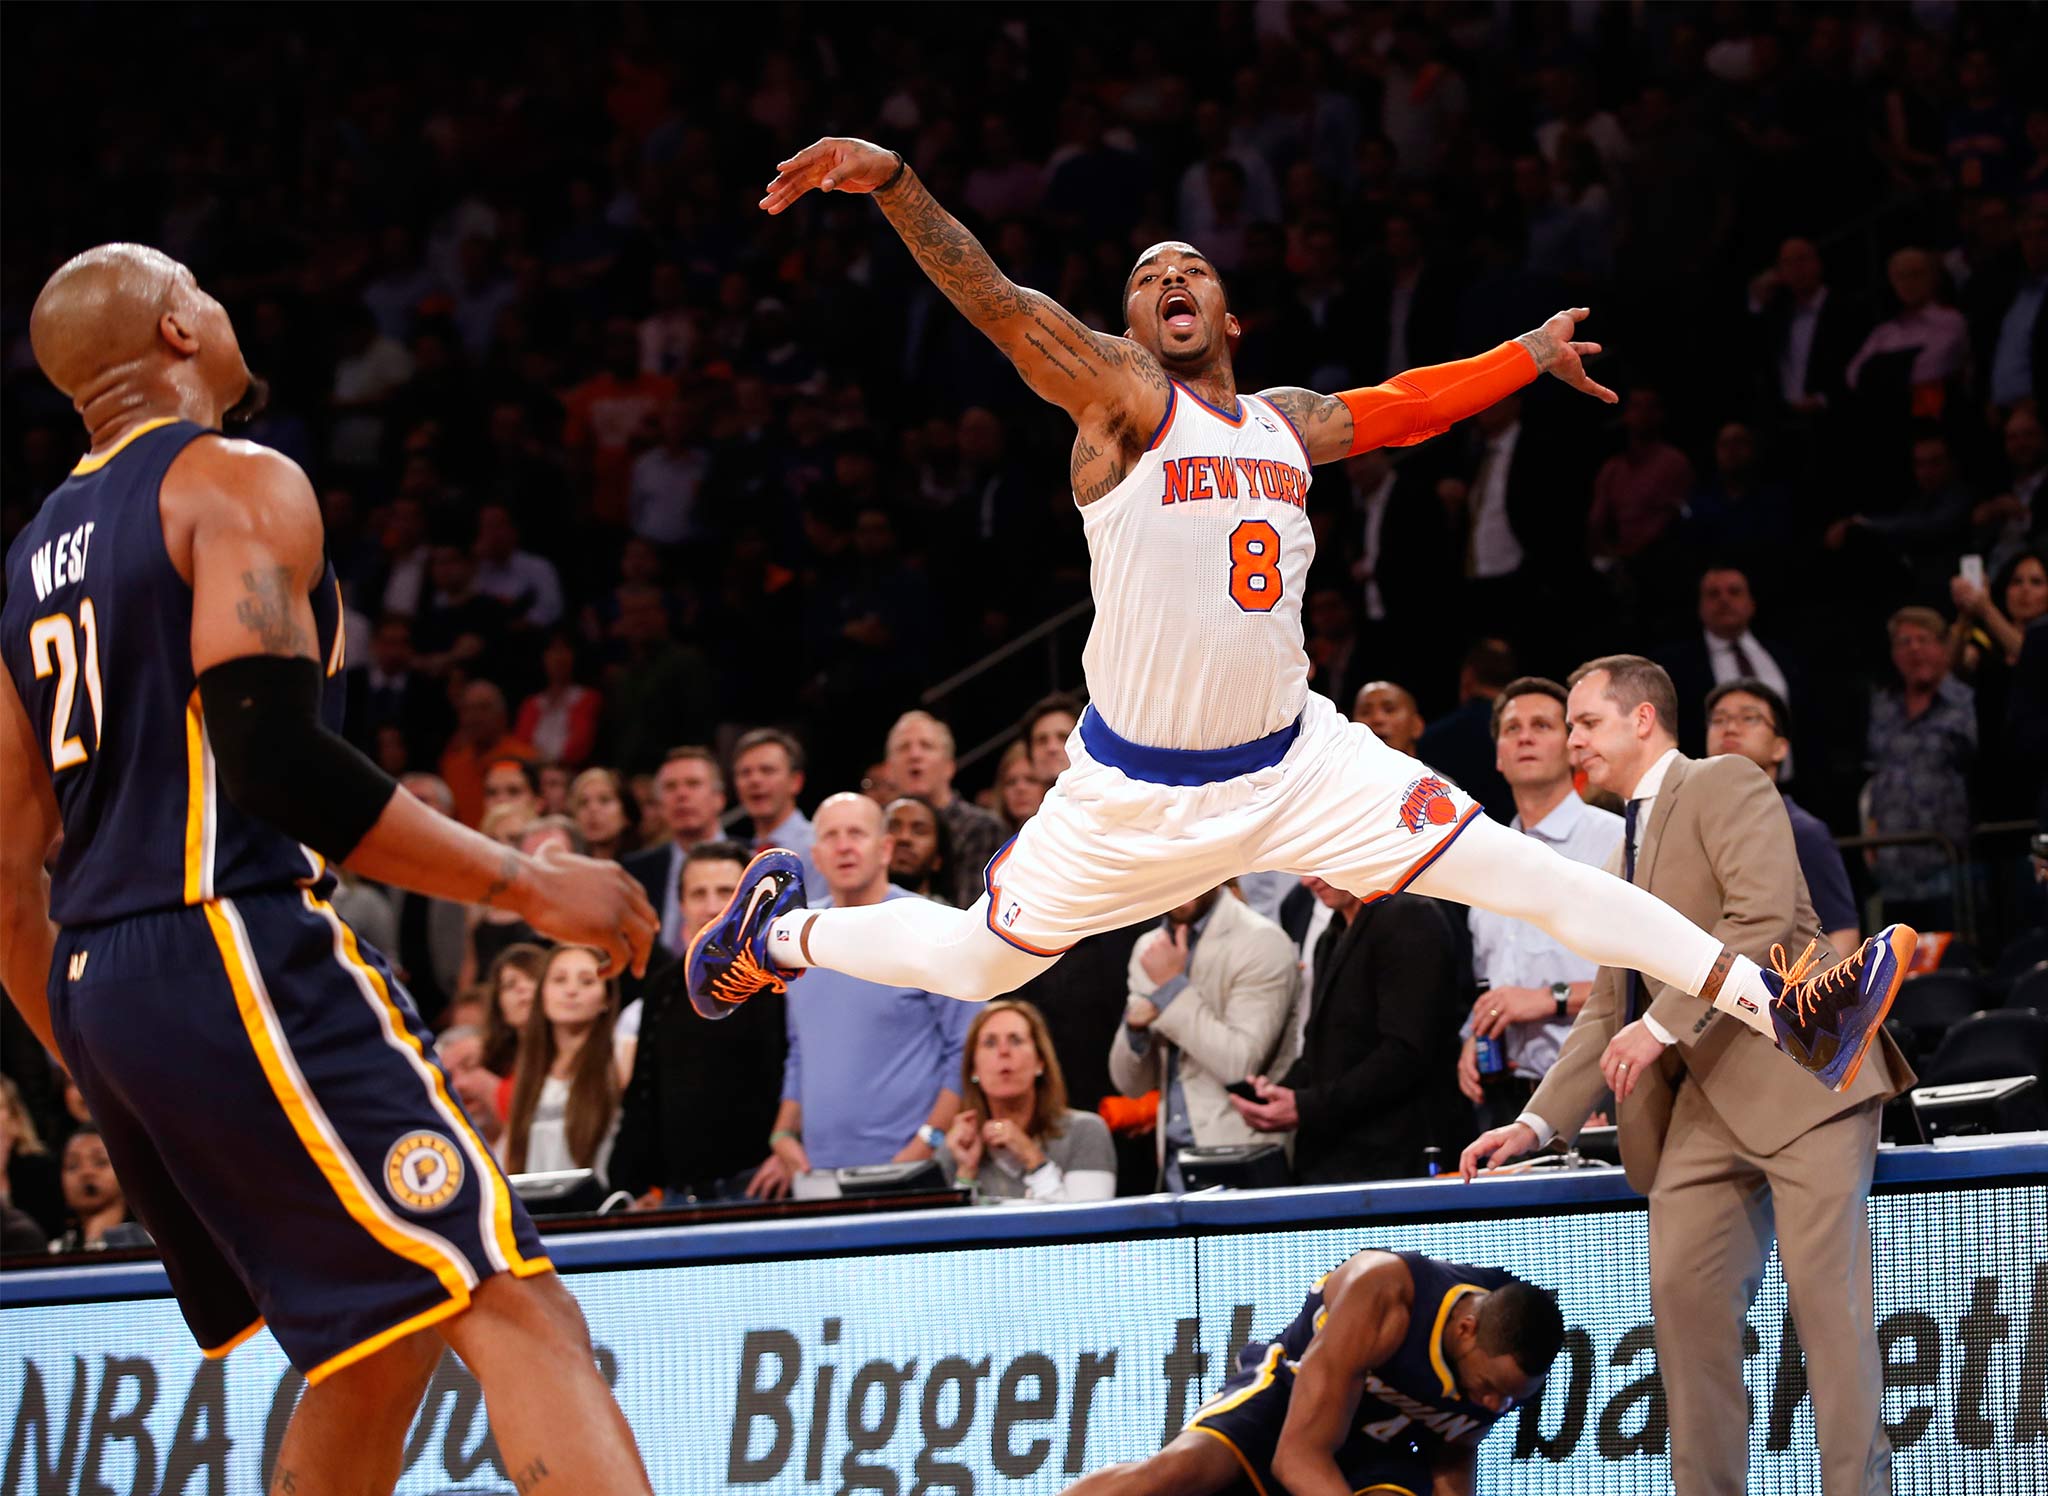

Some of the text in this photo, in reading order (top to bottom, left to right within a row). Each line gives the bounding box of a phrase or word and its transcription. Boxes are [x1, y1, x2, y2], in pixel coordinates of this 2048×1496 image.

[1162, 456, 1307, 511] NEW YORK
[31, 521, 95, 602] WEST
[1229, 519, 1283, 612] 8
[29, 596, 103, 773] 21
[0, 1353, 232, 1496] NBA
[727, 1317, 1118, 1496] Bigger
